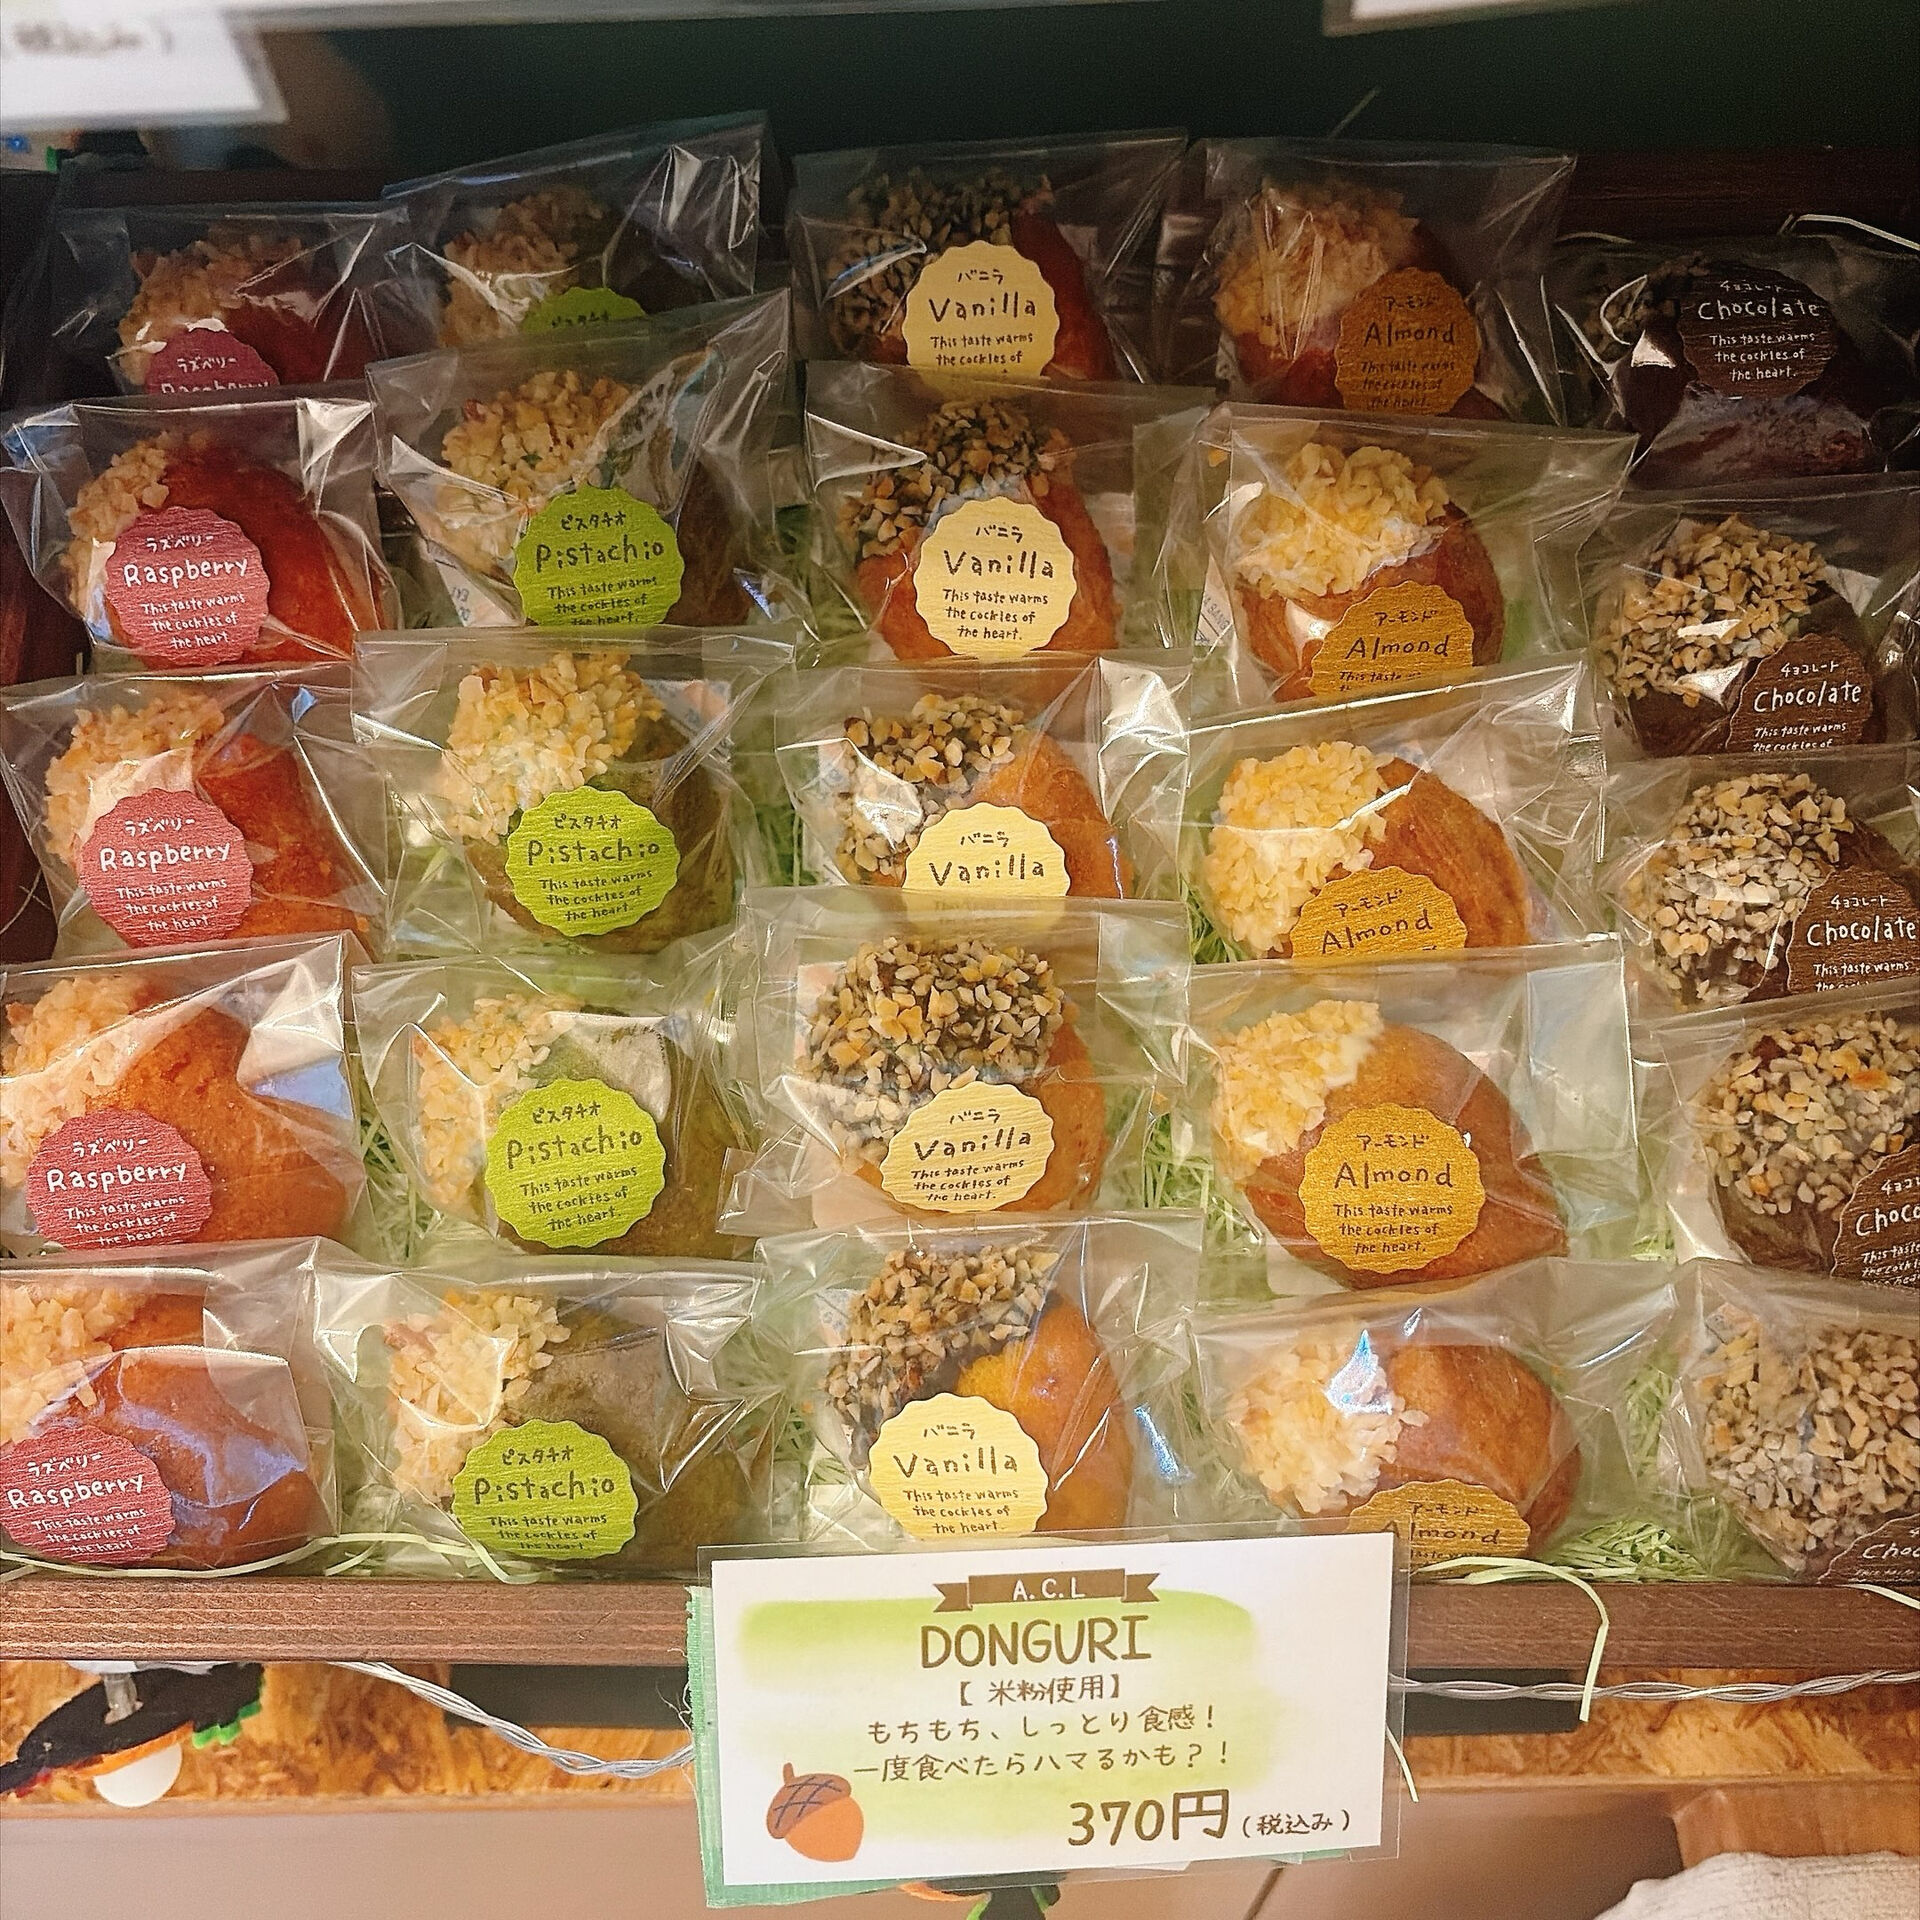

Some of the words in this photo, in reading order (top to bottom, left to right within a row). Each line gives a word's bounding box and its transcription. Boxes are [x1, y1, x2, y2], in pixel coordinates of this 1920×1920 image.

[957, 269, 1004, 284] バニラ
[928, 291, 1036, 322] Vanilla
[1698, 297, 1820, 320] Chocolate
[930, 336, 957, 349] This
[961, 335, 991, 347] taste
[996, 333, 1033, 344] warms
[1364, 322, 1455, 347] Almond
[1709, 335, 1736, 346] This
[1740, 334, 1772, 345] taste
[1776, 333, 1815, 342] warms
[177, 356, 237, 372] ラズベリー
[1715, 351, 1736, 362] the
[1740, 351, 1788, 362] cockles
[1792, 348, 1805, 359] of
[1730, 369, 1751, 381] the
[561, 511, 626, 531] ピスタチオ
[146, 535, 214, 552] ラズベリー
[976, 525, 1023, 543] バニラ
[536, 534, 664, 573] Pistachio
[123, 559, 247, 589] Raspberry
[943, 550, 1053, 579] Vanilla
[547, 586, 576, 599] This
[580, 583, 614, 595] taste
[617, 577, 657, 590] warms
[943, 588, 969, 602] This
[973, 590, 1005, 604] taste
[1009, 592, 1048, 604] warms
[141, 603, 169, 615] This
[171, 599, 203, 613] taste
[207, 592, 246, 609] warms
[151, 620, 173, 632] the
[175, 617, 223, 630] cockles
[225, 612, 238, 625] of
[946, 606, 966, 619] the
[970, 610, 1017, 622] cockles
[1022, 612, 1036, 624] of
[1375, 610, 1437, 626] アーモンド
[958, 626, 978, 637] the
[170, 637, 192, 649] the
[1345, 634, 1449, 660] Almond
[1339, 671, 1365, 682] This
[1781, 661, 1839, 678] チョコレート
[1754, 681, 1861, 712] Chocolate
[1755, 727, 1778, 738] This
[1781, 724, 1809, 737] taste
[1812, 722, 1846, 733] warms
[125, 817, 195, 837] ラズベリー
[554, 813, 621, 829] ピスタチオ
[960, 831, 1009, 847] バニラ
[100, 842, 230, 873] Raspberry
[528, 838, 660, 866] Pistachio
[929, 853, 1045, 886] Vanilla
[116, 886, 145, 899] This
[147, 884, 183, 898] taste
[185, 879, 228, 891] warms
[539, 879, 569, 891] This
[572, 876, 607, 888] taste
[611, 871, 652, 884] warms
[126, 903, 149, 915] the
[152, 899, 201, 914] cockles
[205, 896, 219, 909] of
[546, 895, 570, 905] the
[574, 891, 625, 903] cockles
[629, 886, 642, 898] of
[1333, 889, 1403, 917] アーモンド
[1831, 895, 1888, 910] チョコレート
[147, 920, 168, 931] the
[1322, 909, 1433, 954] Almond
[1807, 915, 1916, 946] Chocolate
[1813, 964, 1838, 977] This
[1841, 963, 1870, 975] taste
[1874, 962, 1909, 972] warms
[532, 1100, 601, 1124] ピスタチオ
[950, 1109, 1000, 1124] バニラ
[73, 1137, 148, 1158] ラズベリー
[507, 1125, 642, 1170] Pistachio
[914, 1126, 1031, 1160] Vanilla
[1356, 1132, 1429, 1151] アーモンド
[47, 1162, 186, 1193] Raspberry
[911, 1170, 940, 1180] This
[945, 1165, 979, 1176] taste
[983, 1160, 1025, 1172] warms
[1334, 1162, 1453, 1189] Almond
[519, 1182, 550, 1197] This
[555, 1175, 589, 1192] taste
[595, 1167, 637, 1183] warms
[914, 1182, 936, 1190] the
[940, 1180, 991, 1190] cockles
[996, 1175, 1011, 1186] of
[529, 1201, 552, 1214] the
[557, 1192, 610, 1209] cockles
[614, 1186, 628, 1198] of
[926, 1193, 948, 1201] the
[64, 1207, 96, 1220] This
[99, 1202, 137, 1215] taste
[141, 1196, 185, 1209] warms
[1333, 1204, 1363, 1217] This
[1368, 1204, 1405, 1218] taste
[1410, 1205, 1453, 1215] warms
[75, 1223, 99, 1233] the
[103, 1218, 158, 1231] cockles
[163, 1212, 177, 1222] of
[546, 1218, 571, 1231] the
[1339, 1223, 1362, 1235] the
[1366, 1225, 1419, 1236] cockles
[1425, 1223, 1439, 1234] of
[1354, 1243, 1376, 1254] the
[1861, 1250, 1887, 1264] This
[924, 1423, 975, 1439] バニラ
[27, 1452, 103, 1477] ラズベリー
[502, 1445, 573, 1465] ピスタチオ
[893, 1446, 1017, 1478] Vanilla
[7, 1474, 143, 1509] Raspberry
[474, 1470, 615, 1504] Pistachio
[903, 1489, 932, 1502] This
[936, 1490, 971, 1502] taste
[976, 1489, 1019, 1499] warms
[32, 1520, 62, 1531] This
[66, 1515, 101, 1527] taste
[104, 1509, 147, 1521] warms
[487, 1517, 519, 1527] This
[522, 1516, 558, 1527] taste
[562, 1514, 607, 1525] warms
[913, 1506, 936, 1516] the
[940, 1507, 992, 1517] cockles
[997, 1505, 1010, 1516] of
[47, 1533, 70, 1543] the
[74, 1529, 124, 1540] cockles
[128, 1524, 141, 1535] of
[933, 1523, 955, 1534] the
[921, 1614, 1152, 1669] DONGURI
[1068, 1788, 1230, 1846] 370円
